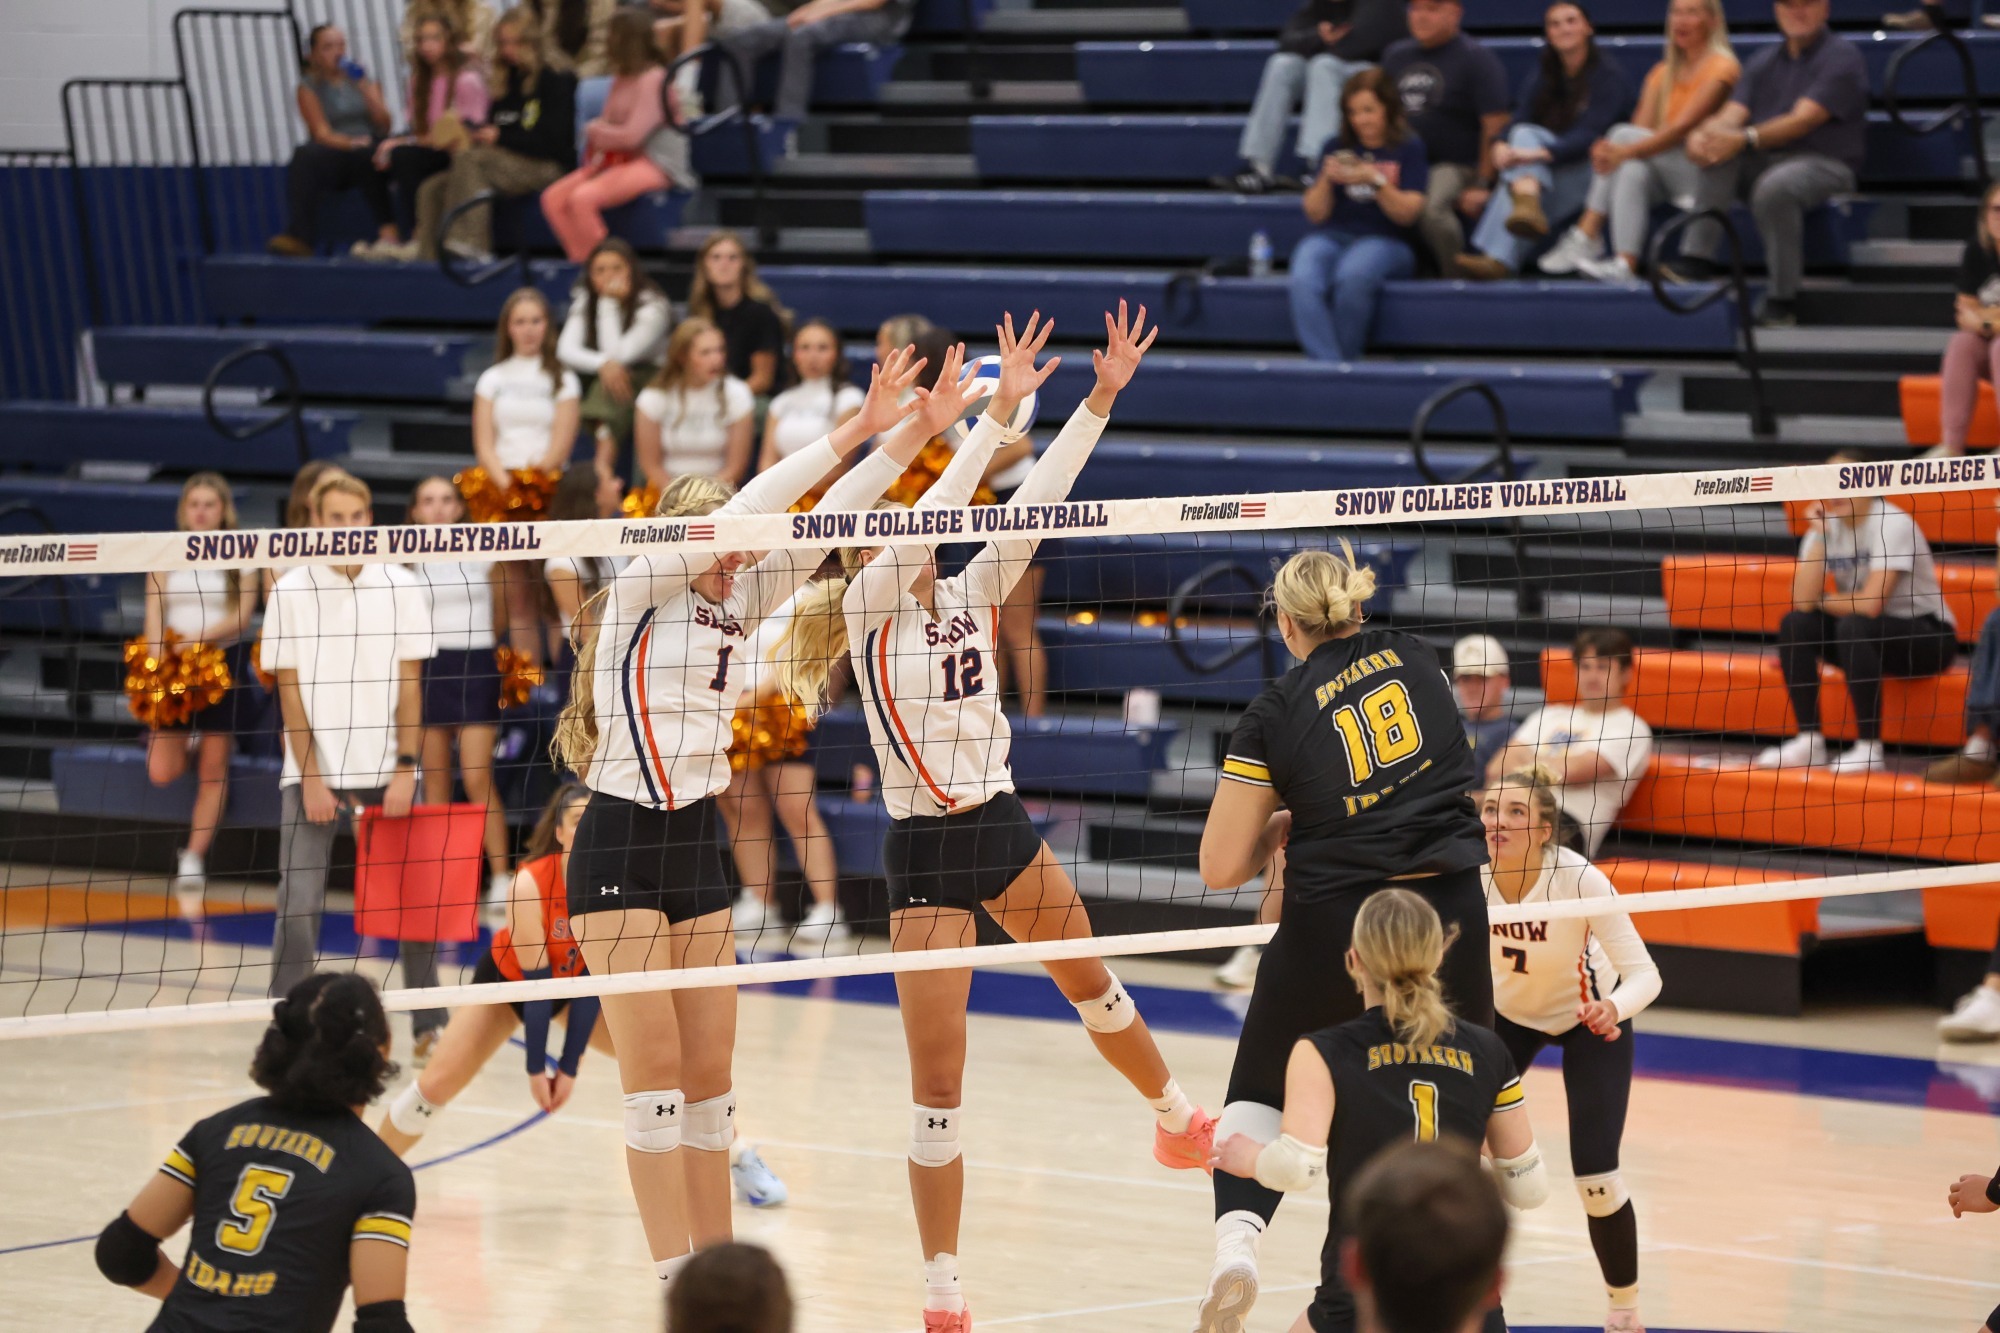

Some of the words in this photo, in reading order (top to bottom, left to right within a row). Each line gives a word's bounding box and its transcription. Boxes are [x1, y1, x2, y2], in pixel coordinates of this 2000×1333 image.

[1694, 477, 1750, 496] FreeTaxUSA
[1839, 464, 1895, 489] SNOW
[1900, 458, 1986, 486] COLLEGE
[1180, 501, 1240, 521] FreeTaxUSA
[1334, 490, 1396, 516] SNOW
[1402, 485, 1493, 513] COLLEGE
[1500, 479, 1626, 508] VOLLEYBALL
[620, 524, 686, 544] FreeTaxUSA
[792, 513, 858, 540] SNOW
[864, 509, 963, 537] COLLEGE
[971, 503, 1108, 532] VOLLEYBALL
[0, 543, 66, 563] reeTaxUSA
[186, 533, 259, 561] SNOW
[268, 530, 378, 558] COLLEGE
[387, 525, 541, 554] VOLLEYBALL
[709, 645, 733, 692] 1
[941, 647, 984, 702] 12
[1315, 649, 1403, 710] SOUTHERN
[1332, 679, 1423, 787] 18
[1491, 921, 1548, 942] NOW
[1502, 946, 1530, 974] 7
[1368, 1043, 1474, 1076] SOUTHERN
[1408, 1079, 1439, 1144] 1
[224, 1124, 336, 1174] SOUTHERN
[215, 1162, 296, 1256] 5
[186, 1251, 278, 1297] IDAHO
